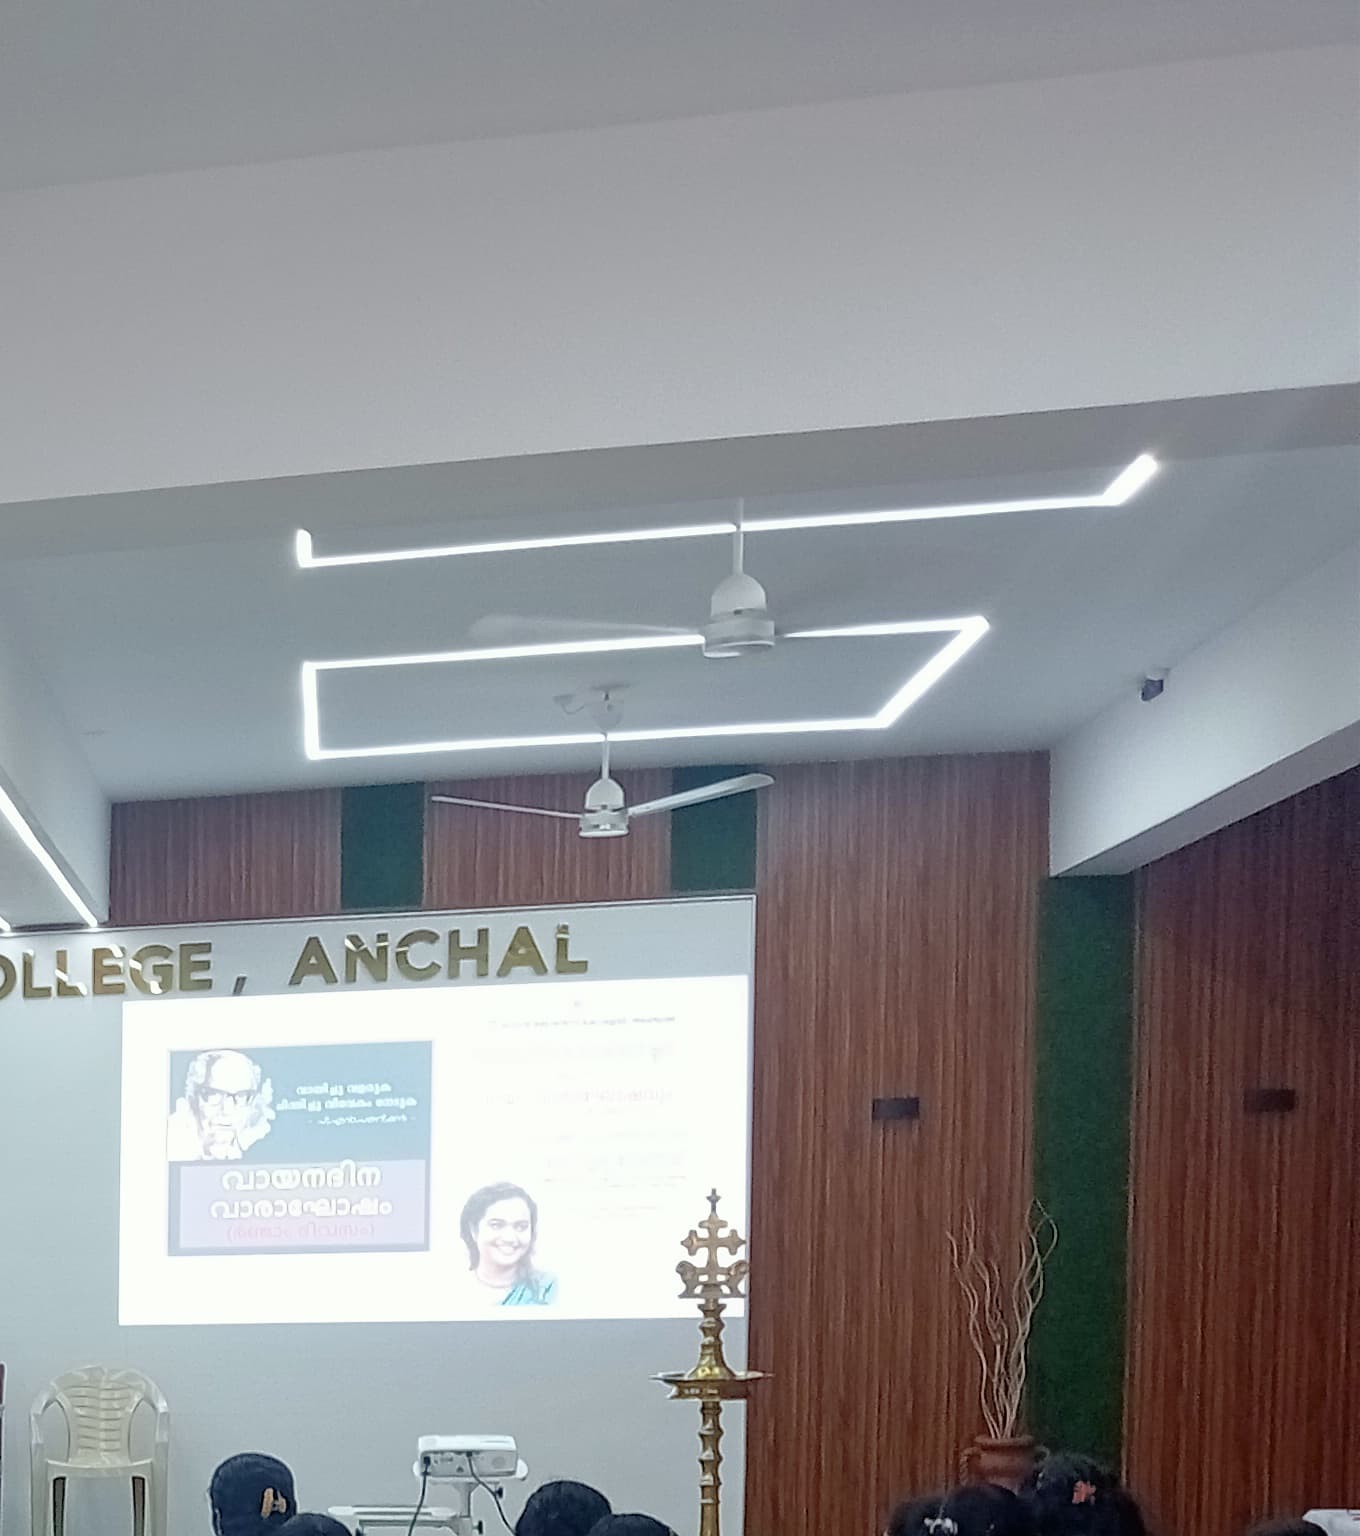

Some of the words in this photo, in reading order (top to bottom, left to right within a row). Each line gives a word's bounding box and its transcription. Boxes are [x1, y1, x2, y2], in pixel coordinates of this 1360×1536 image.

[288, 923, 589, 985] ANCHAL
[222, 1158, 382, 1191] വായനദിന
[210, 1196, 393, 1219] വാരാഘോഷം
